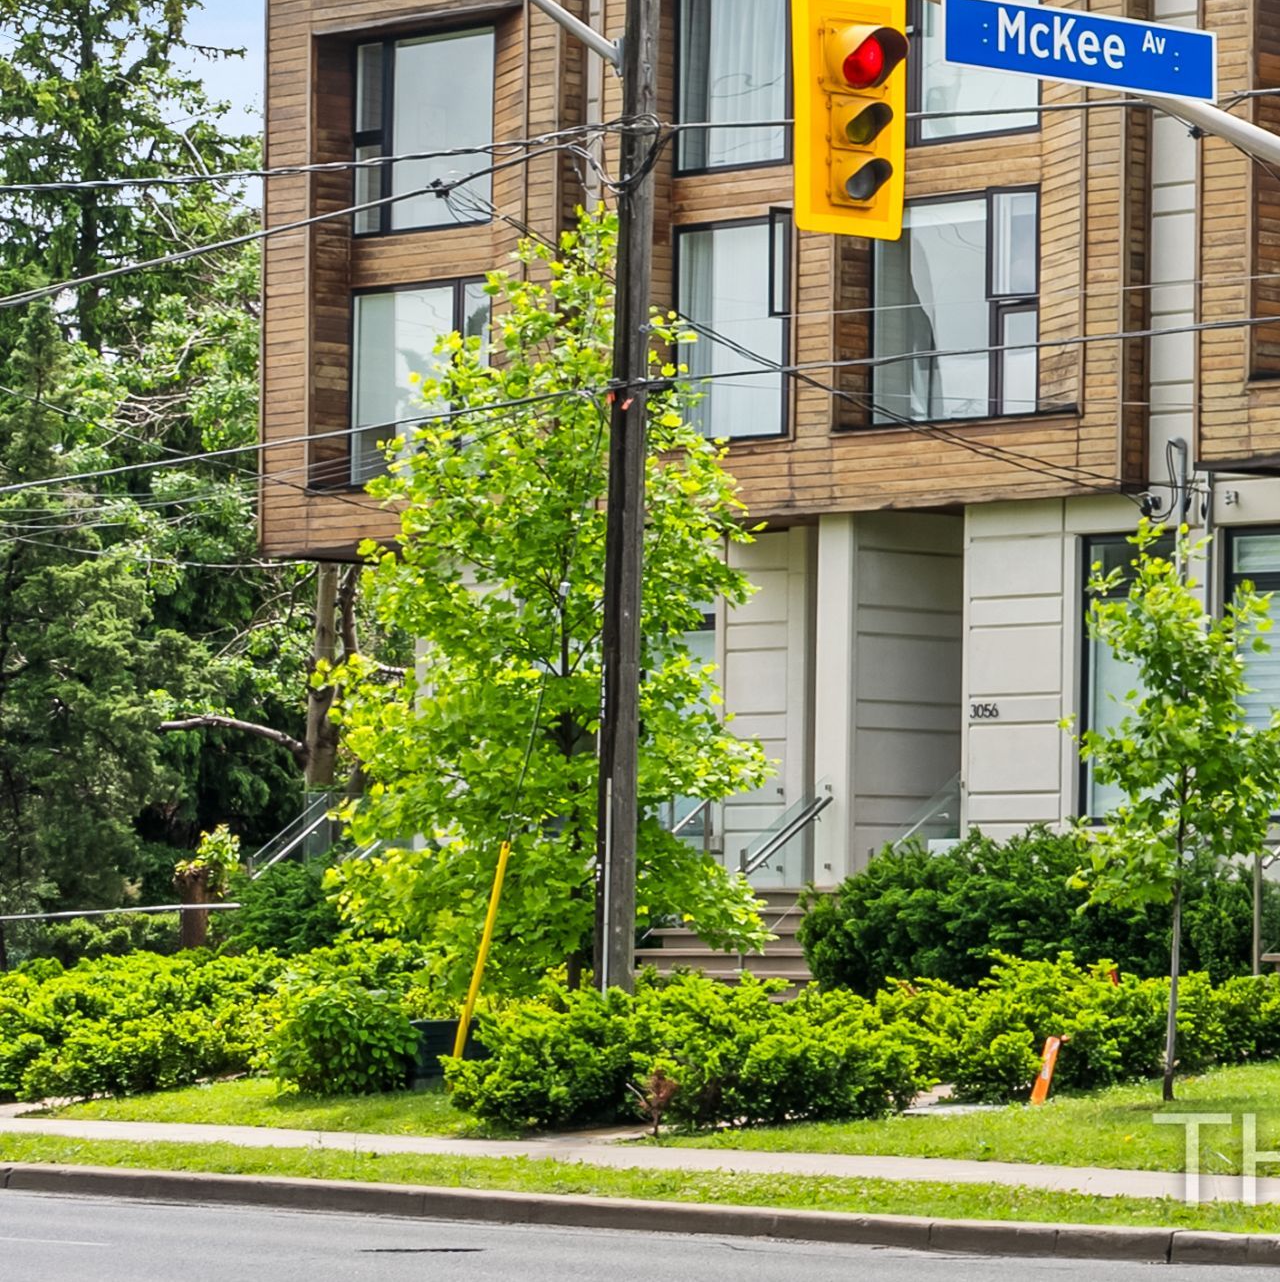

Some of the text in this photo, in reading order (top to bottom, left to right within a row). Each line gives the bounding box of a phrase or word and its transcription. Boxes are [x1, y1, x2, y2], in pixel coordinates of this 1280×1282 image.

[997, 7, 1166, 70] McKee Av
[969, 703, 999, 719] 3056
